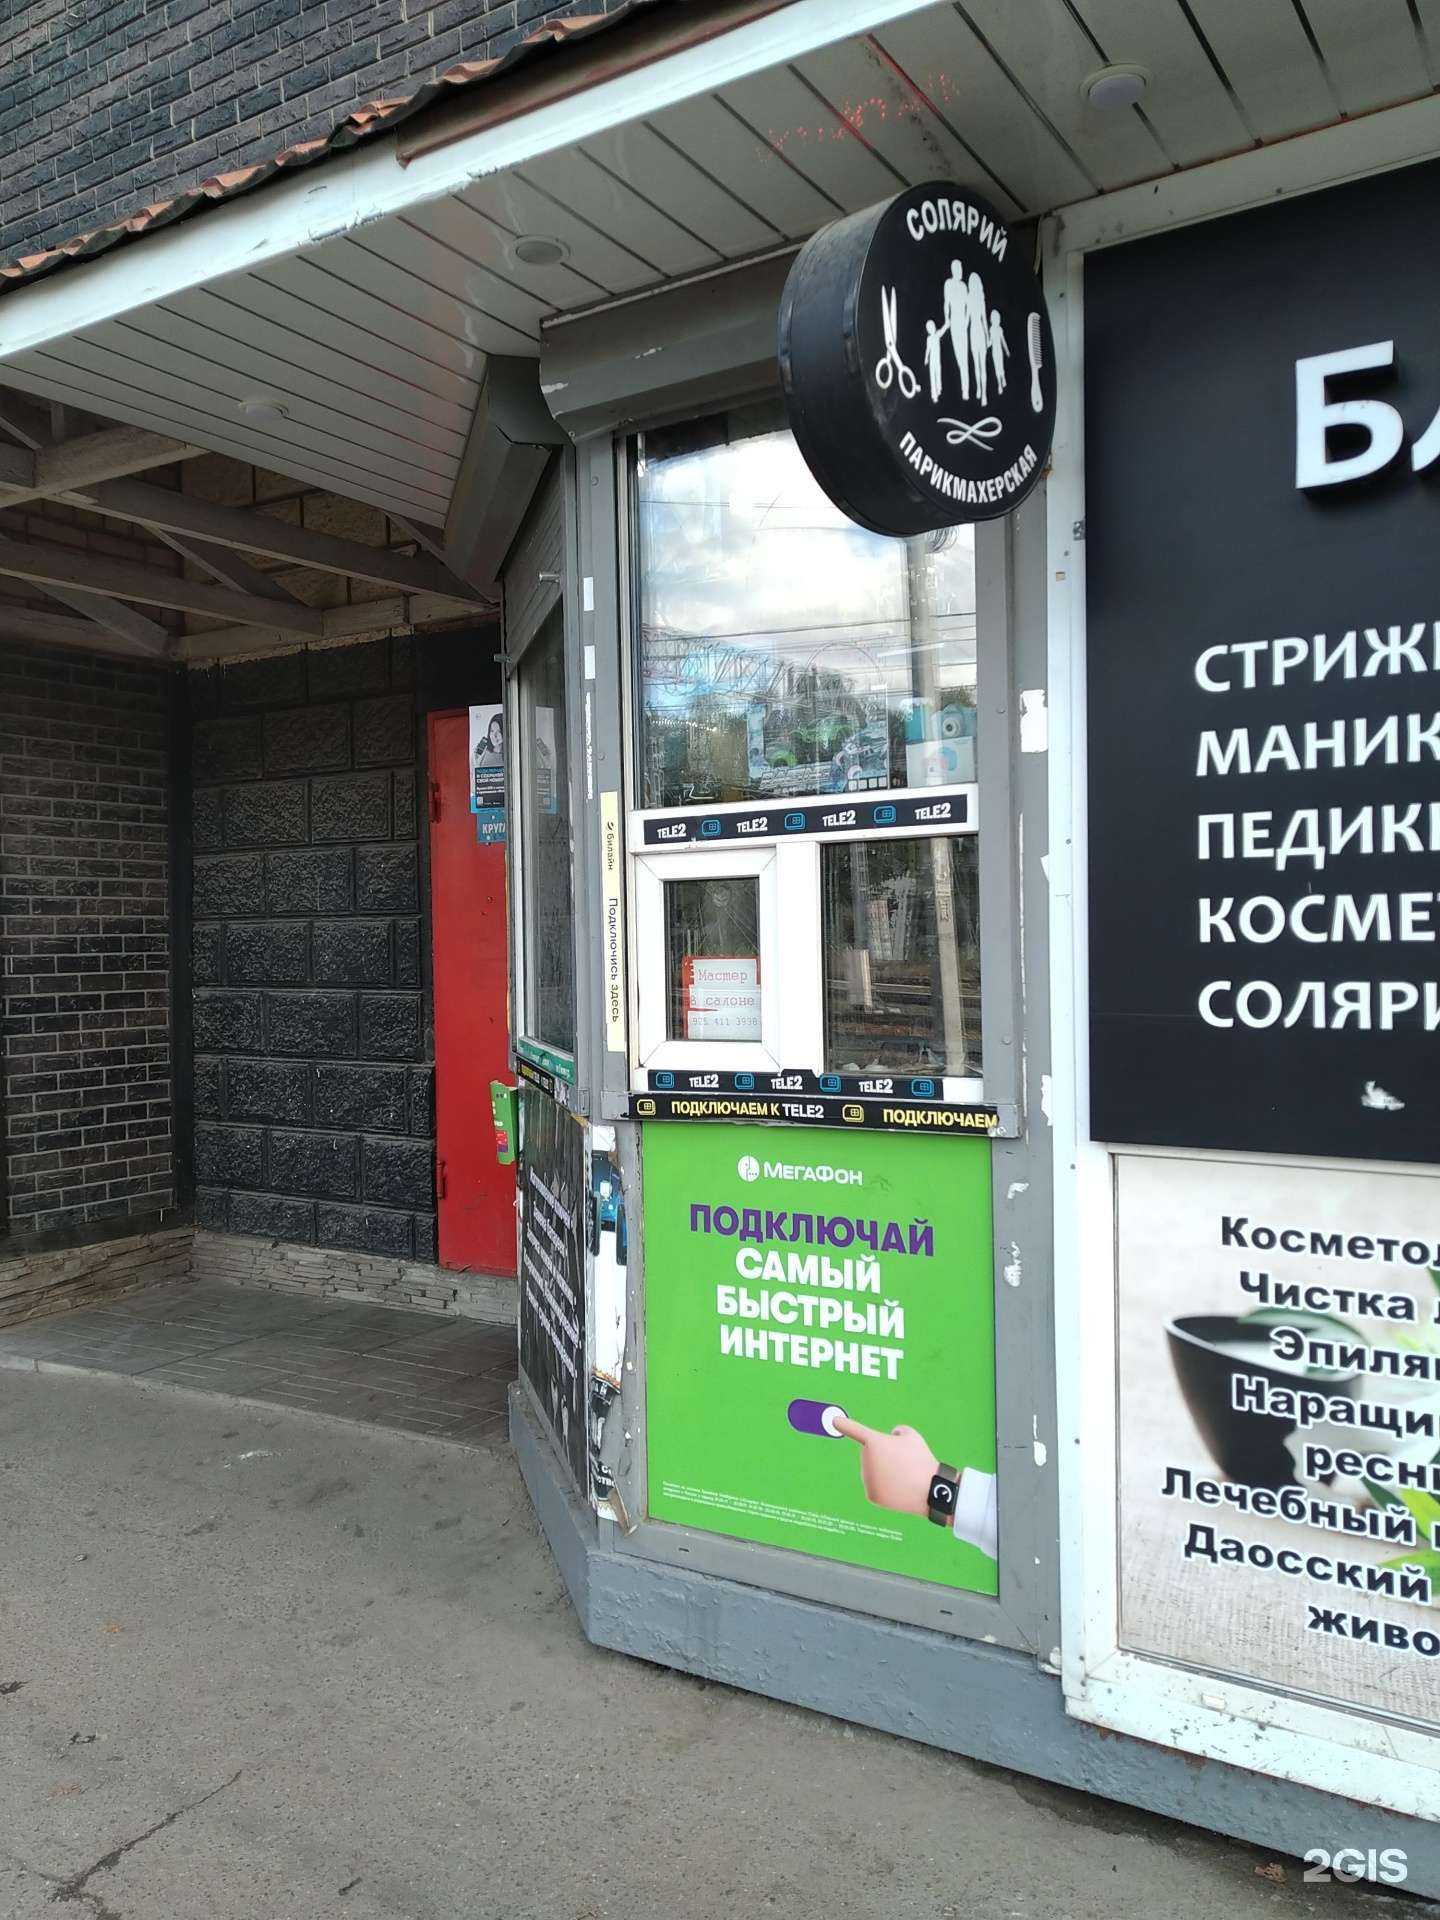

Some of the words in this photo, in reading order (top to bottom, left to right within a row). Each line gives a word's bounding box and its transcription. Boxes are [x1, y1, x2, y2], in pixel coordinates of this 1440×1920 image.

[900, 432, 1038, 503] ПАРИКМАХЕРСКАЯ
[1194, 620, 1440, 692] СТРИЖ
[1196, 711, 1440, 776] МАНИК
[657, 823, 687, 839] TELE2
[736, 816, 768, 833] TELE2
[822, 809, 856, 827] TELE2
[914, 802, 951, 820] TELE2
[1198, 802, 1440, 871] ПЕДИК
[608, 898, 618, 980] Подключись
[1198, 892, 1440, 943] КОСМЕ
[610, 984, 620, 1023] здесь
[671, 1101, 768, 1116] ПОДКЛЮЧАЕМ
[770, 1103, 780, 1116] К
[782, 1103, 824, 1118] TELE2
[689, 1074, 719, 1089] TELE2
[770, 1075, 803, 1090] TELE2
[859, 1079, 893, 1094] TELE2
[883, 1108, 997, 1128] ПОДКЛЮЧАЕМ
[690, 1203, 935, 1257] ПОДКЛЮЧАЙ
[1221, 1216, 1440, 1266] Космето
[735, 1247, 881, 1294] САМЫЙ
[1239, 1271, 1415, 1321] Чистка
[716, 1284, 905, 1340] БЫСТРЫЙ
[720, 1324, 904, 1380] ИНТЕРНЕТ
[1271, 1329, 1440, 1381] Эпиля
[1305, 1445, 1440, 1494] ресн
[1162, 1467, 1414, 1543] Лечебный
[1184, 1523, 1429, 1602] Даосский
[1308, 1605, 1440, 1656] живо
